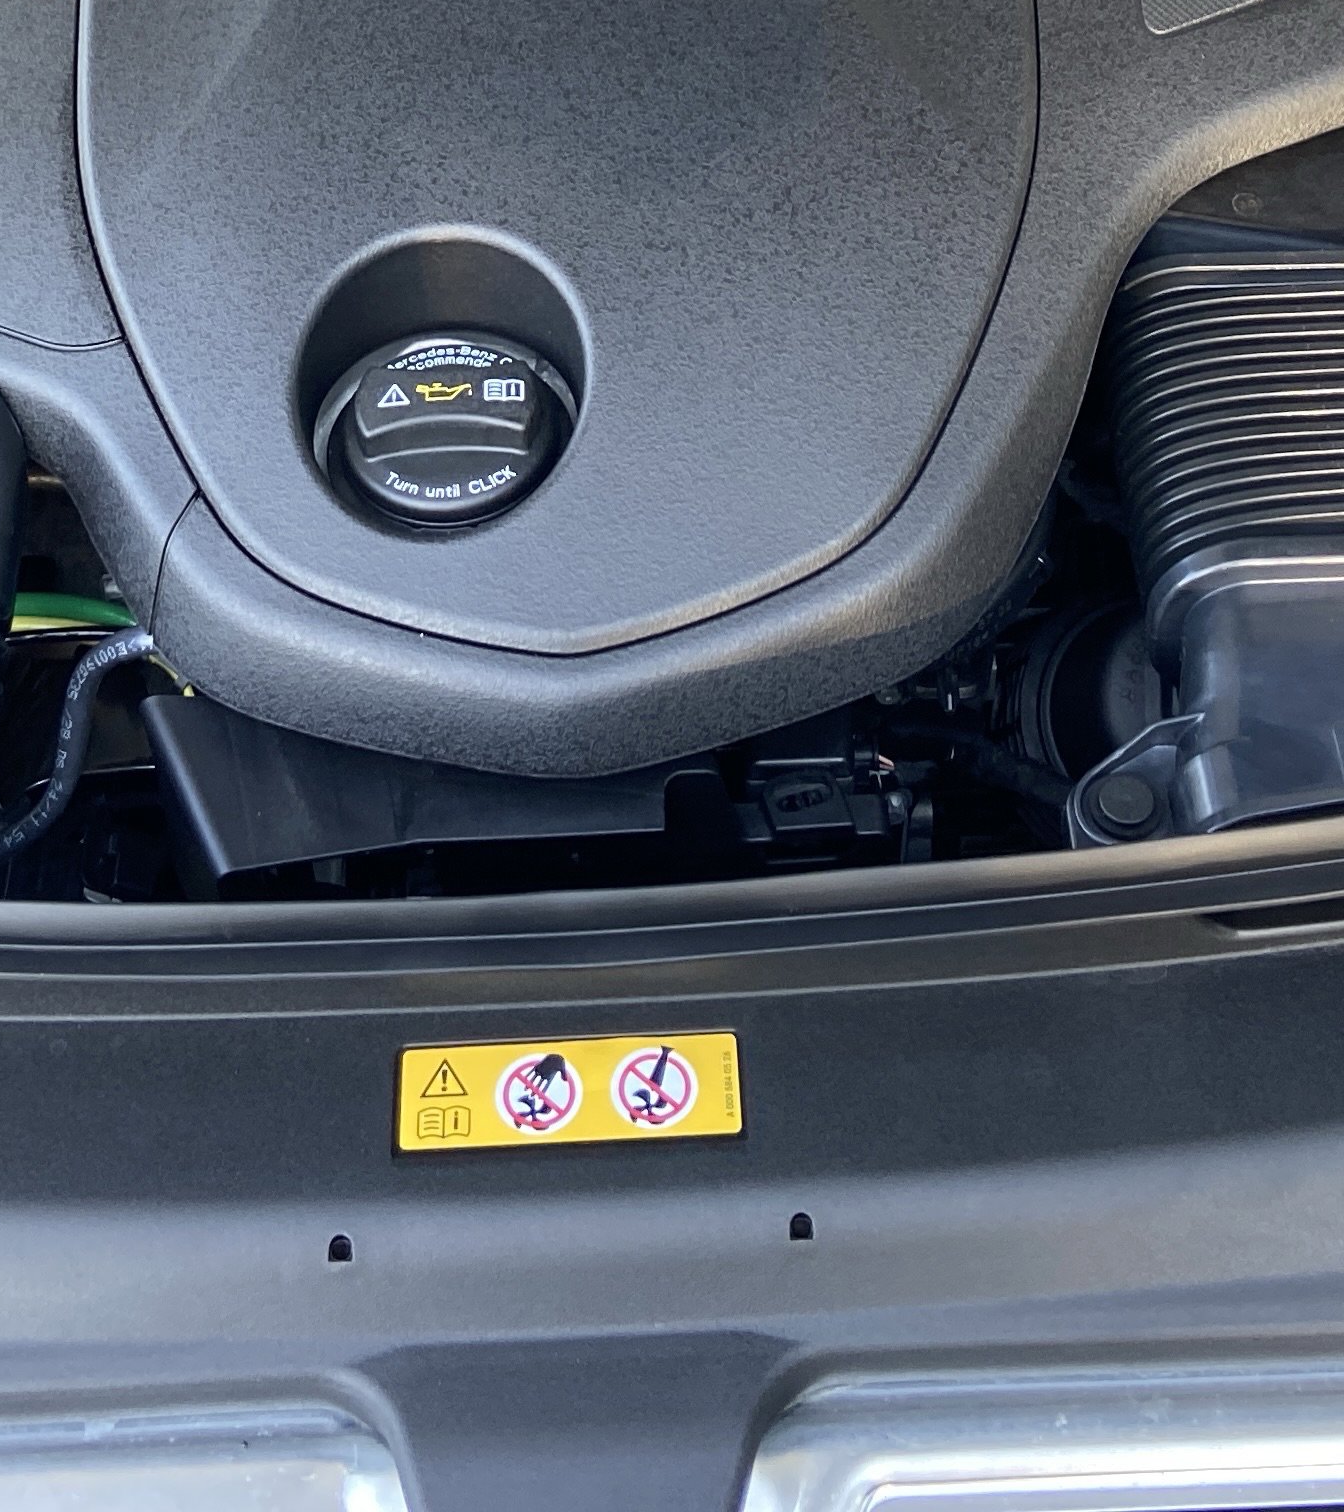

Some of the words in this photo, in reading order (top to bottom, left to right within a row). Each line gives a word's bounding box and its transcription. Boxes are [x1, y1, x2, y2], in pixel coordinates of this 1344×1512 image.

[385, 471, 420, 496] Turn
[425, 483, 461, 499] until
[468, 464, 517, 495] CLICK
